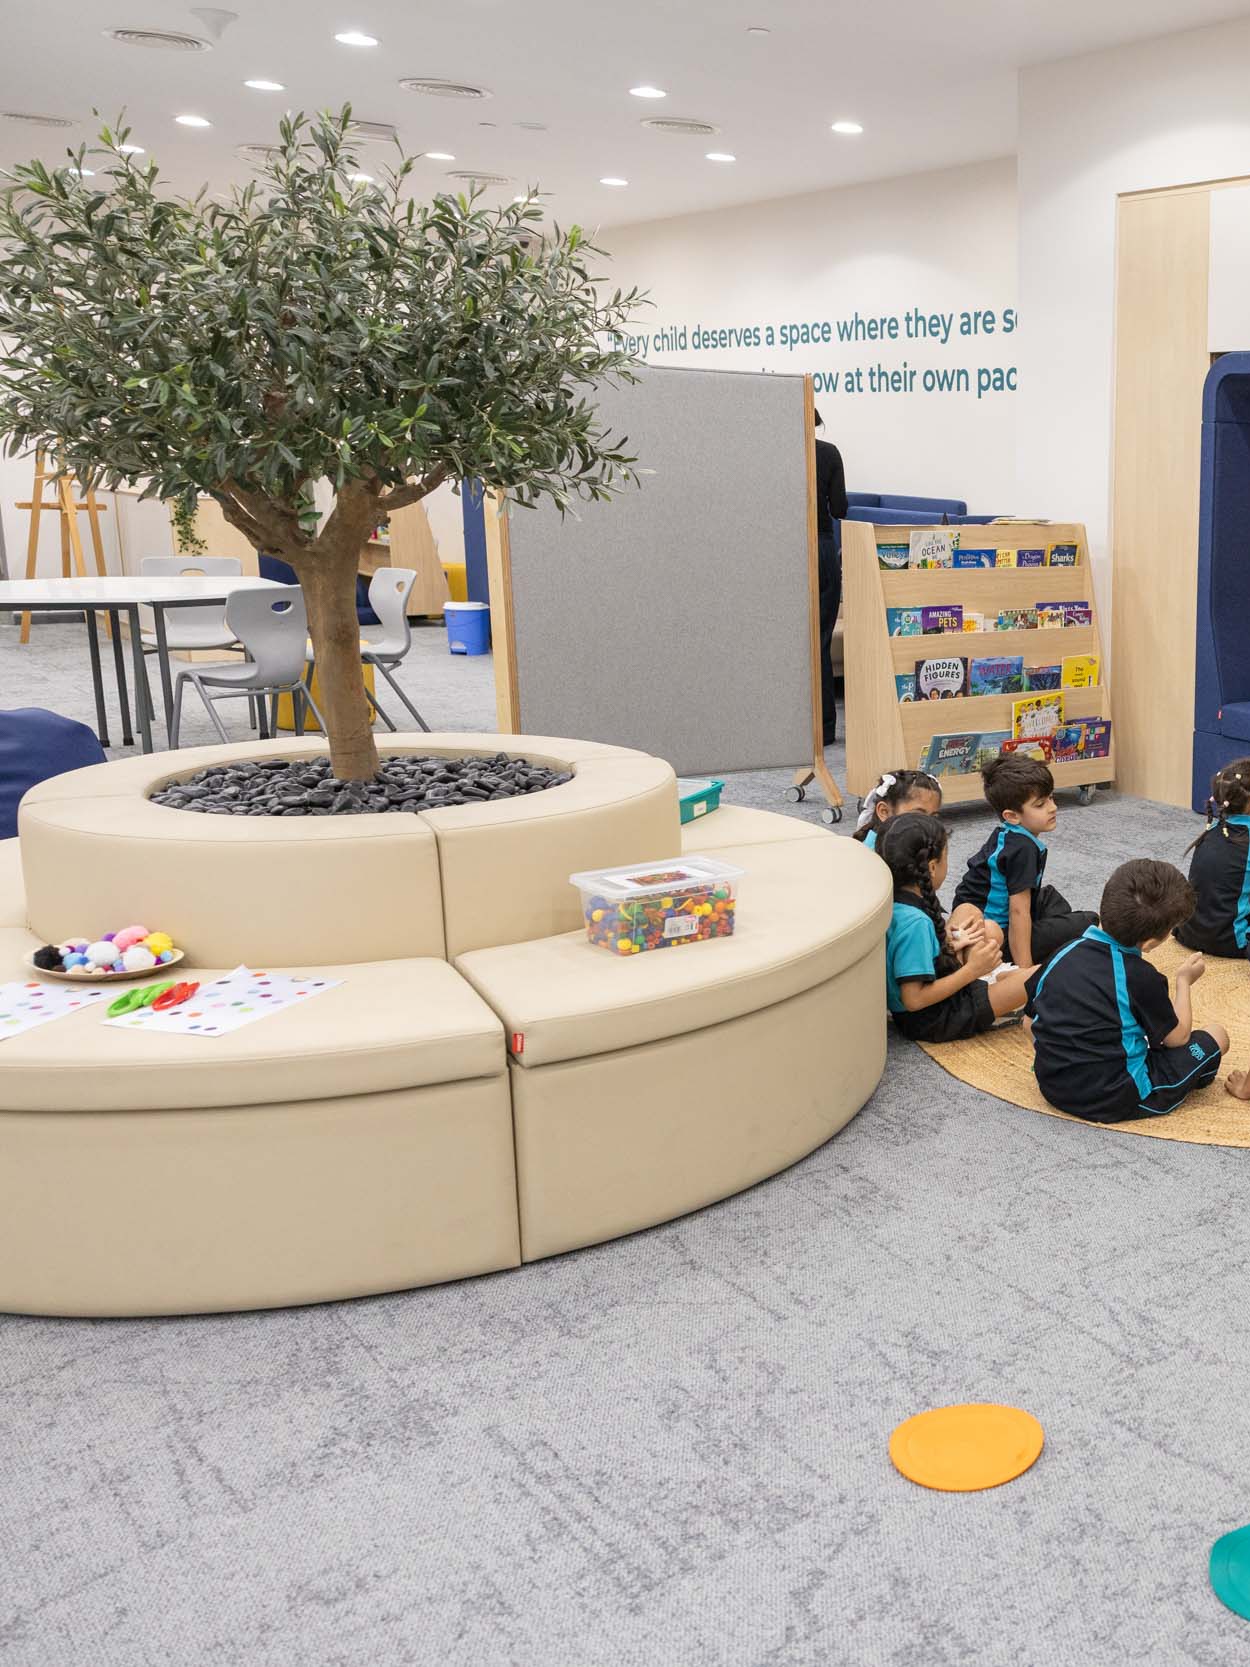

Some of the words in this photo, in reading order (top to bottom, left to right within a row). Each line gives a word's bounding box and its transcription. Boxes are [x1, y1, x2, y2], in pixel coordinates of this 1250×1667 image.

[653, 326, 687, 352] child
[692, 324, 761, 351] deserves
[765, 326, 775, 346] a
[780, 321, 832, 351] space
[837, 312, 899, 342] where
[905, 307, 953, 345] they
[960, 309, 996, 336] are
[1002, 308, 1017, 333] s
[844, 367, 863, 393] at
[869, 361, 917, 393] their
[923, 367, 970, 392] own
[922, 544, 946, 557] OCEAN
[1051, 552, 1074, 562] Sharks
[928, 610, 952, 619] AMAZING
[938, 617, 958, 628] PETS
[925, 661, 959, 674] HIDDEN
[923, 670, 961, 682] FIGURES
[938, 746, 971, 759] ENERGY
